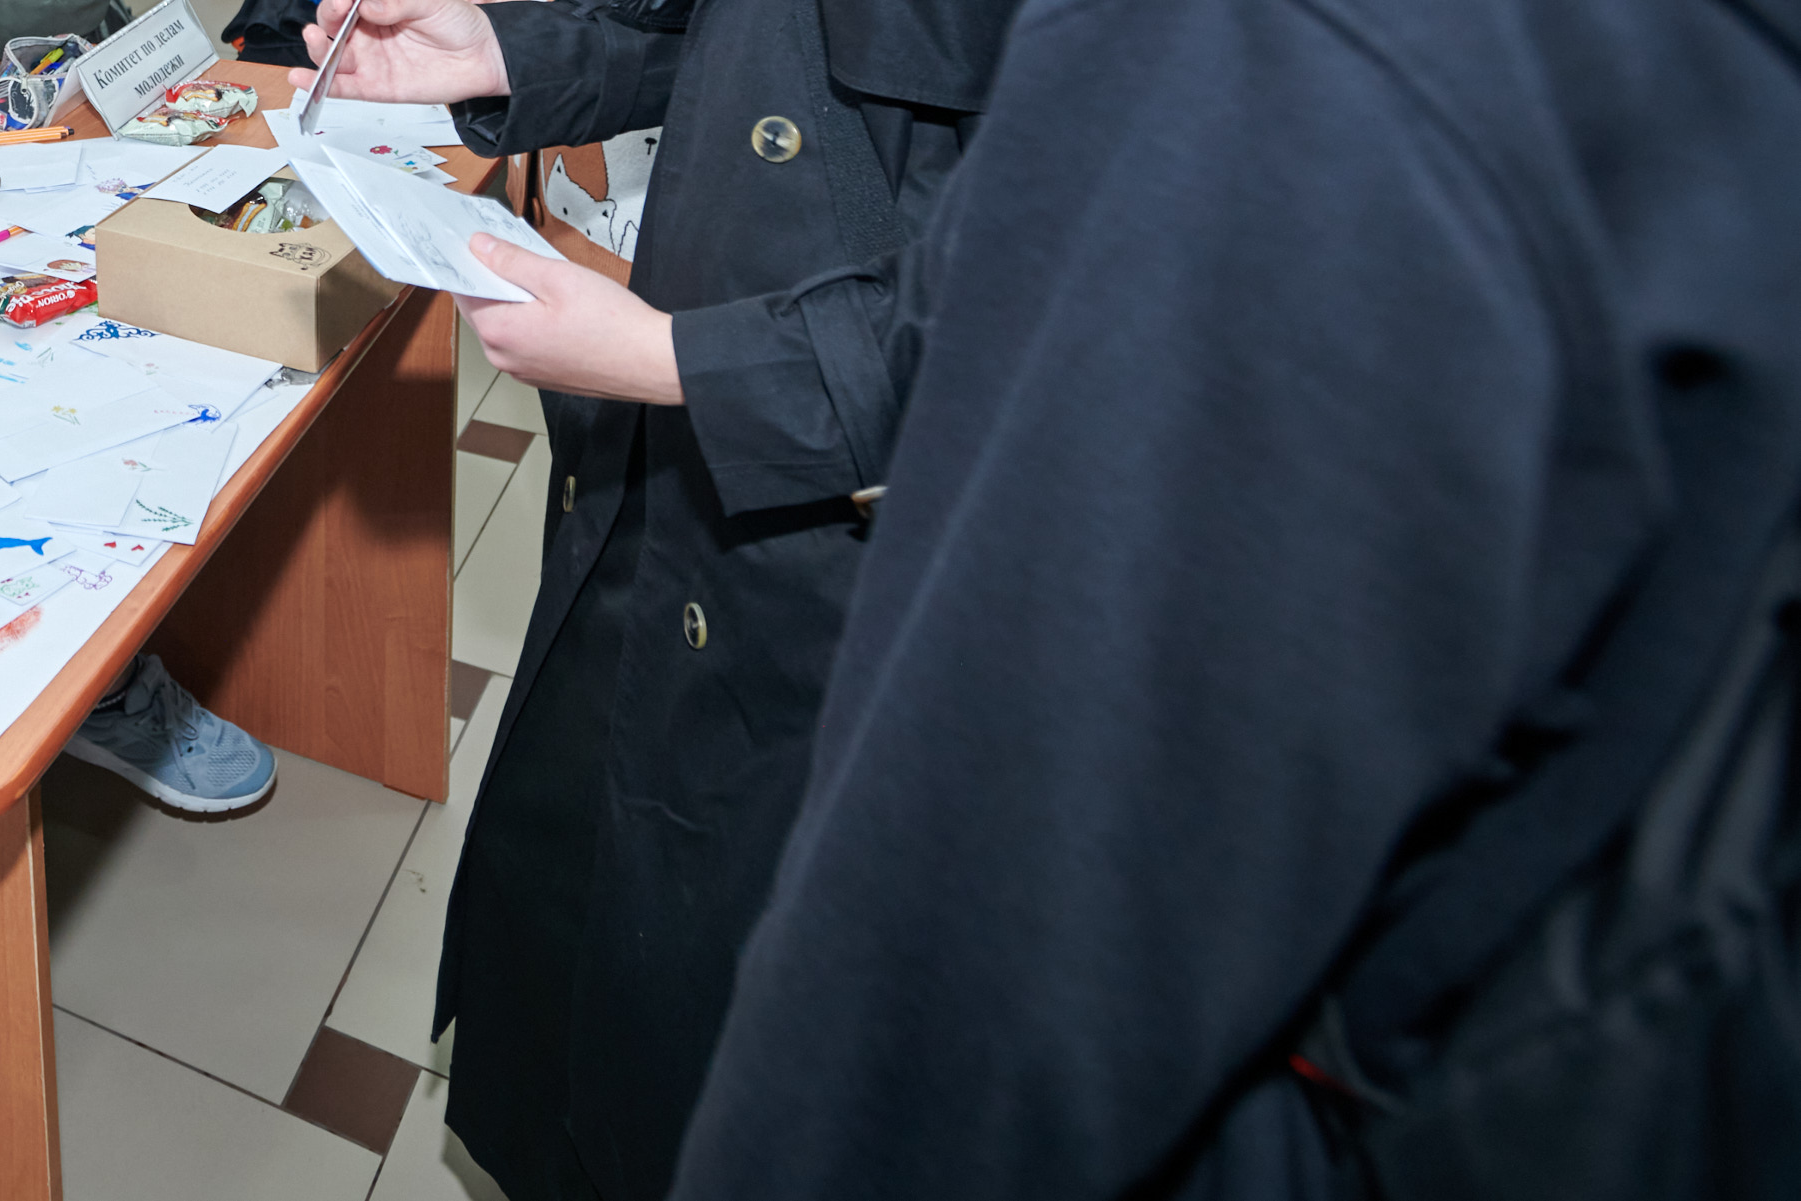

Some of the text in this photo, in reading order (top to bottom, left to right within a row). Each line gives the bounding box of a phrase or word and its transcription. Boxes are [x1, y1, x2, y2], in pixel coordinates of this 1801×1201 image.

[93, 49, 143, 90] Комитет
[140, 40, 156, 57] по
[155, 19, 185, 48] делам
[134, 54, 185, 99] молодежи
